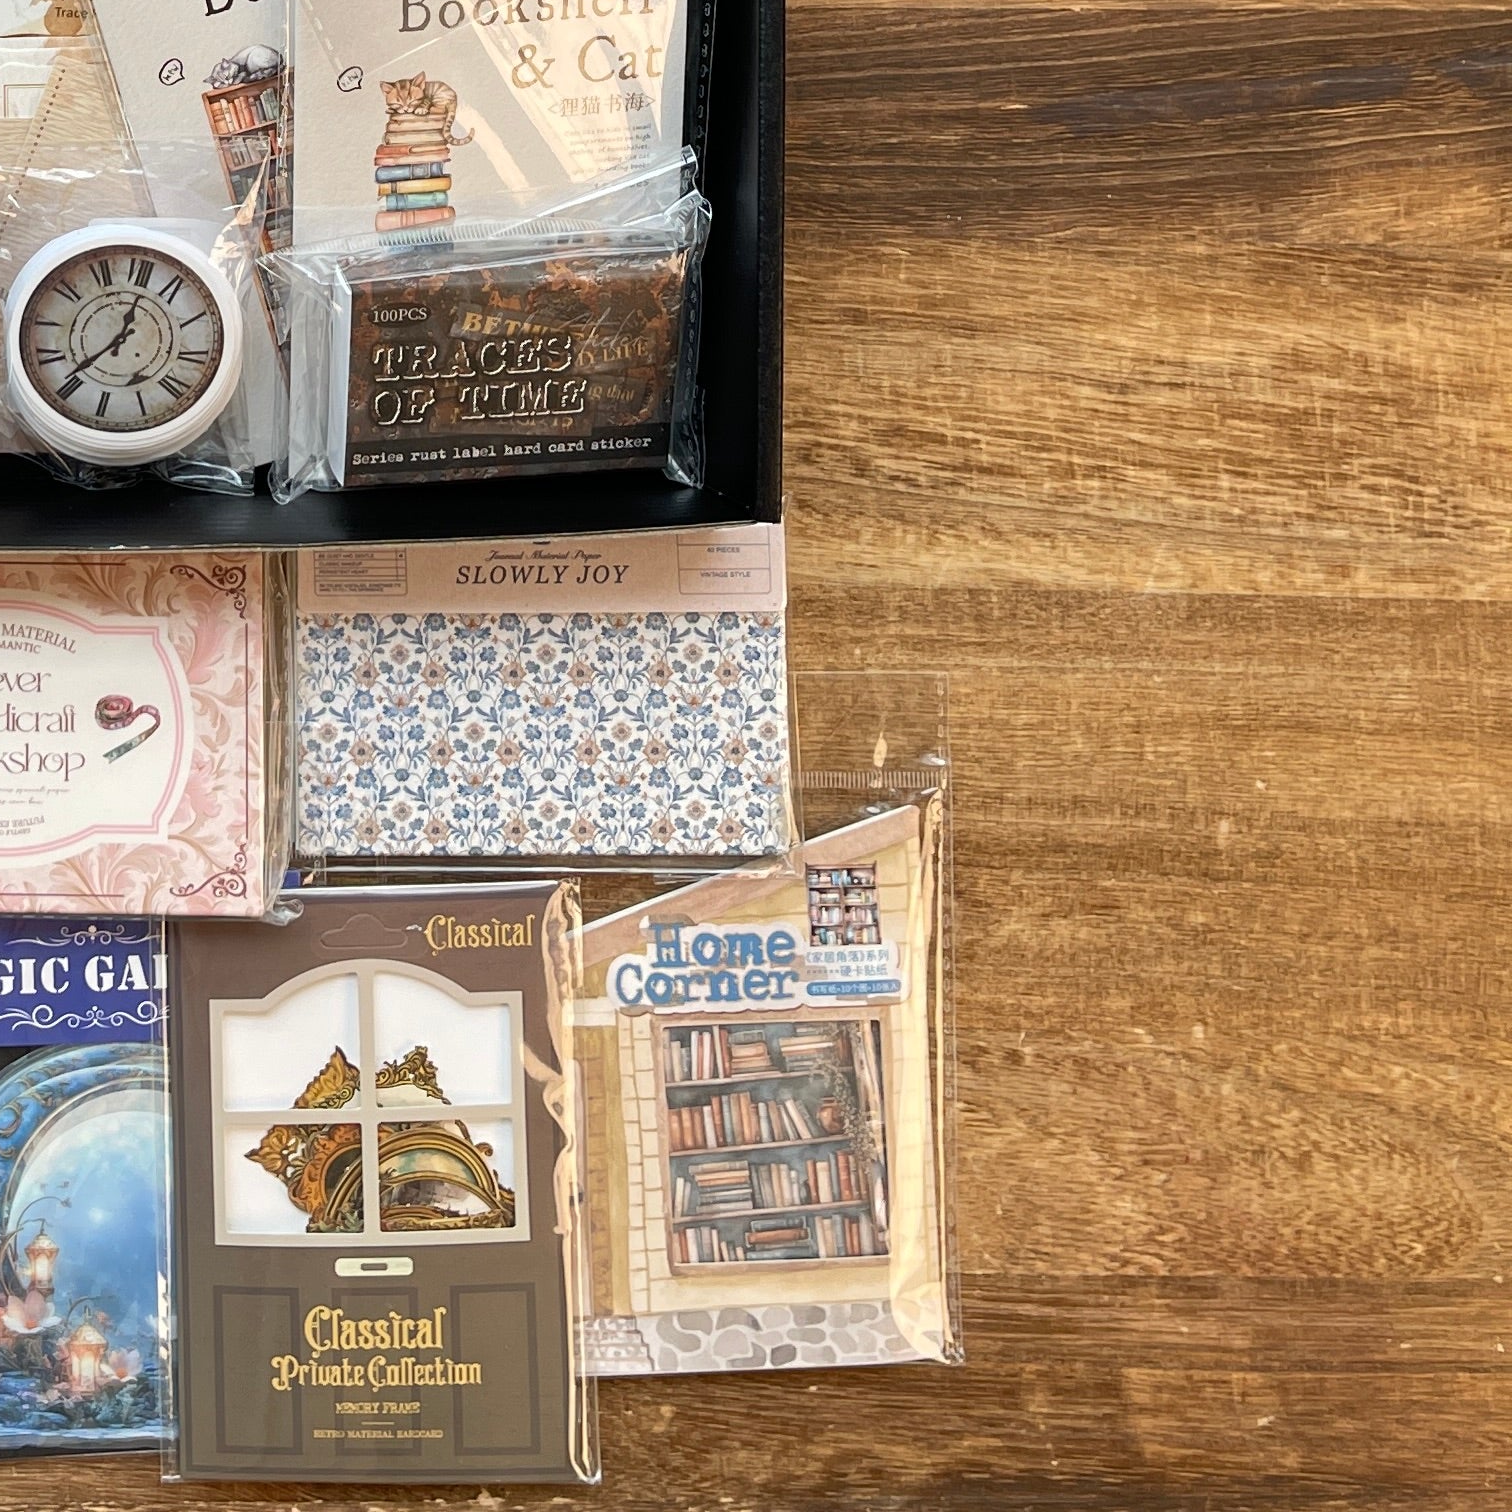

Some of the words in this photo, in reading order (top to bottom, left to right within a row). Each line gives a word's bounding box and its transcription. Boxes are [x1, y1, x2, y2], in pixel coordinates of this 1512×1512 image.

[55, 6, 89, 19] Trace
[511, 42, 555, 90] &
[577, 34, 664, 83] Cat
[370, 306, 428, 324] 100PCS
[371, 335, 575, 384] TRACES
[374, 387, 437, 426] OF
[459, 378, 589, 421] TIME
[351, 451, 405, 466] Series
[410, 446, 447, 461] rust
[451, 443, 497, 459] label
[503, 439, 543, 456] hard
[546, 436, 585, 454] card
[590, 433, 652, 451] sticker
[455, 564, 571, 585] SLOWLY
[575, 564, 630, 585] JOY
[0, 621, 78, 656] MATERIAL
[423, 913, 537, 956] Classical
[649, 921, 797, 969] Home
[613, 961, 800, 1005] Corner
[303, 1304, 447, 1353] Classical
[270, 1354, 366, 1392] Private
[366, 1354, 483, 1393] Collection
[335, 1401, 381, 1415] MEMORY
[381, 1401, 421, 1415] FRAME
